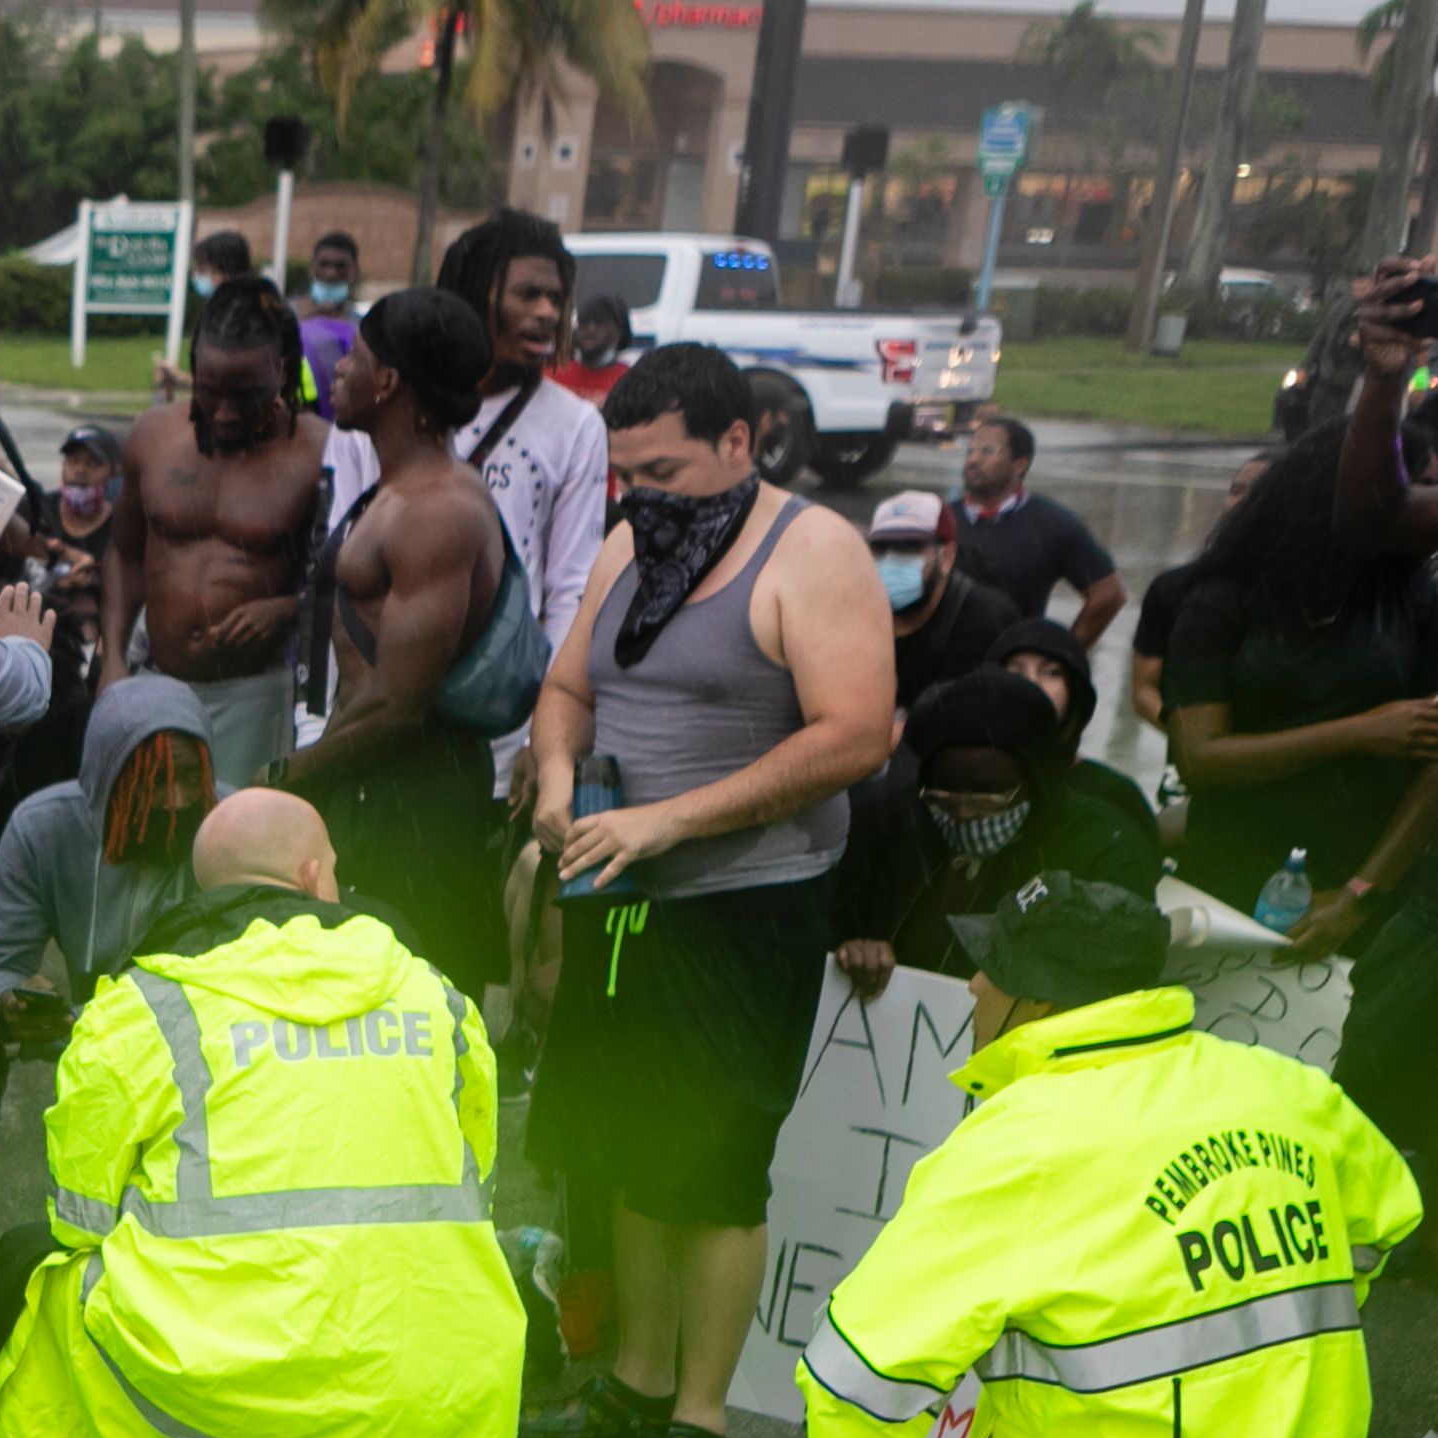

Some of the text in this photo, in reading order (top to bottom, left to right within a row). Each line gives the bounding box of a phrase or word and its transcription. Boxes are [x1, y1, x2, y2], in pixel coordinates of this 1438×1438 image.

[230, 1009, 434, 1067] POLICE
[1144, 1128, 1316, 1226] PEMBROKE PINES
[1176, 1199, 1328, 1292] POLICE
